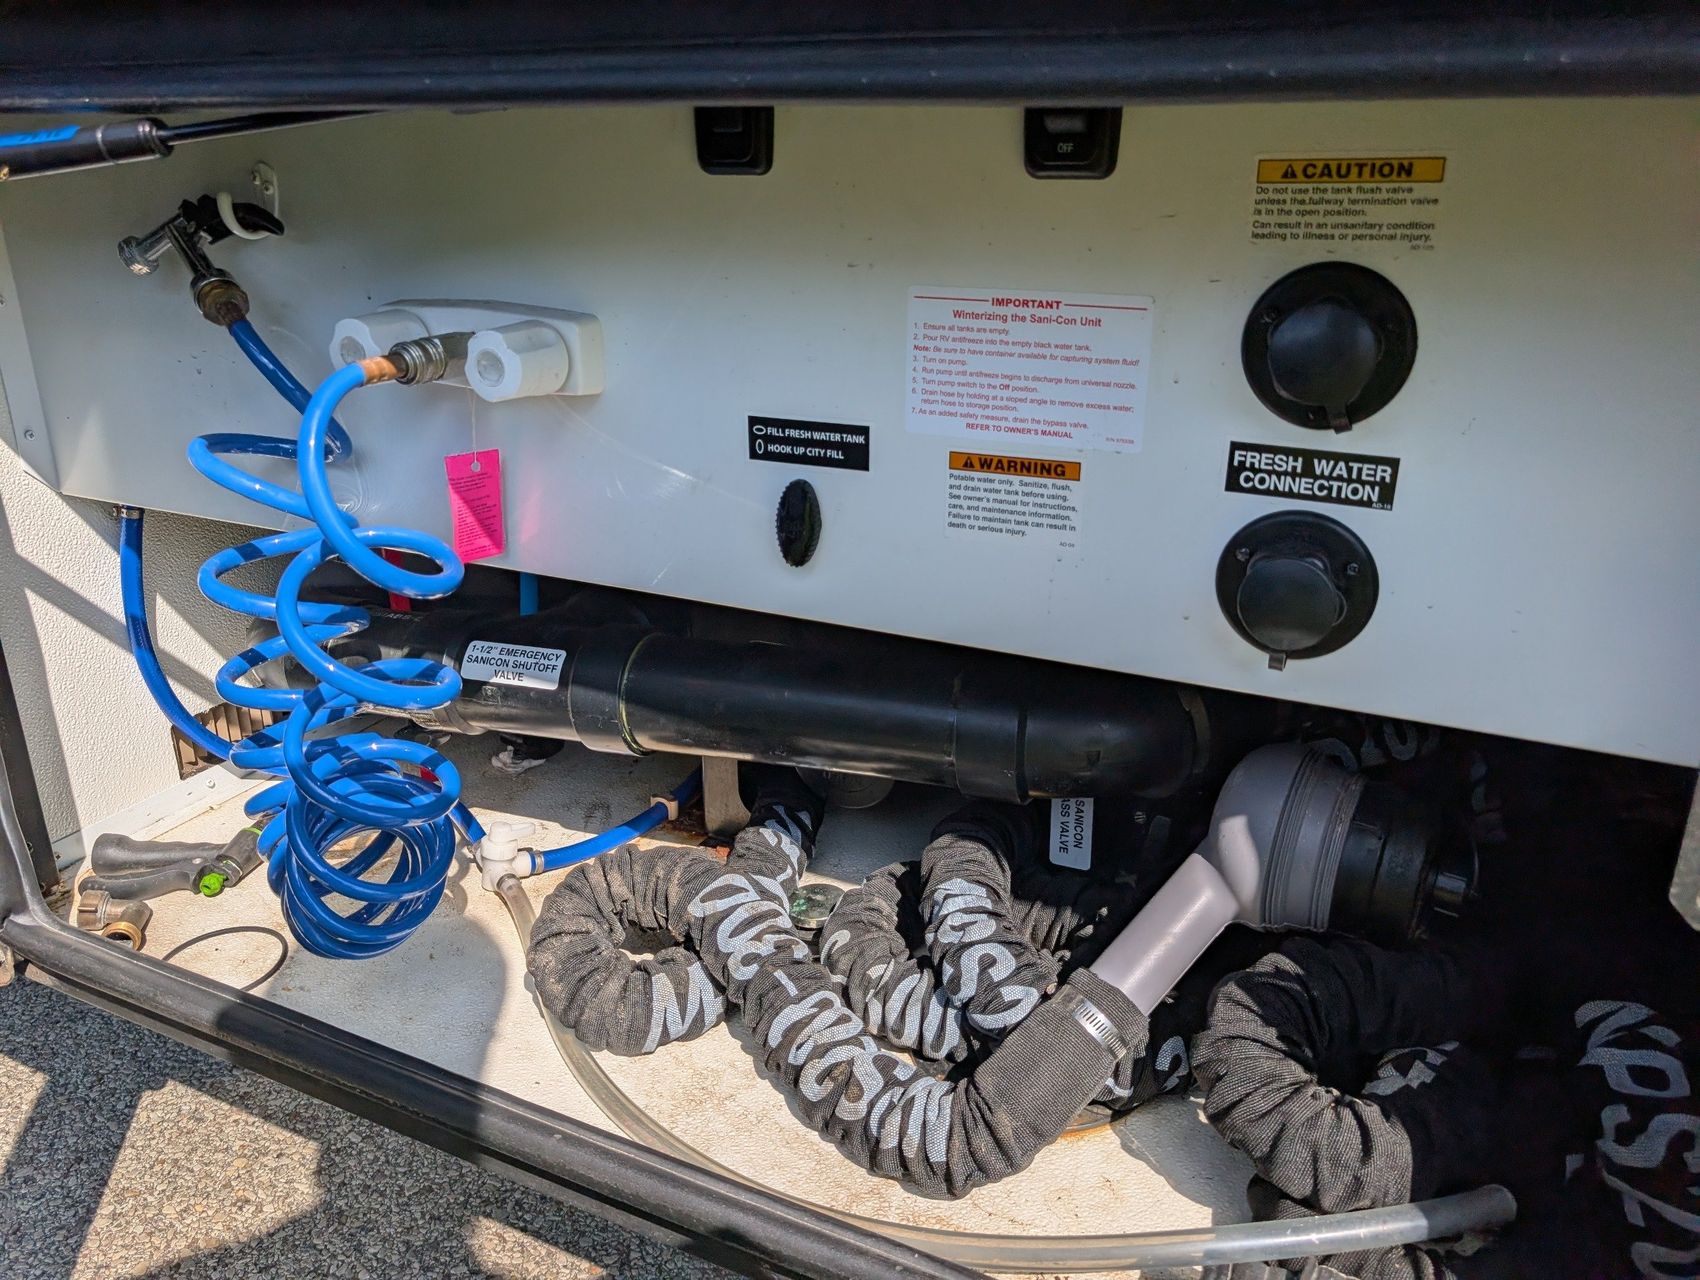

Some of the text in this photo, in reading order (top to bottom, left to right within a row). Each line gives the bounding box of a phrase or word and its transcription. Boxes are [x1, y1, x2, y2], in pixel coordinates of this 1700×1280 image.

[1057, 142, 1074, 153] OFF
[1302, 162, 1413, 178] CAUTION
[1257, 186, 1269, 194] Do
[1272, 186, 1288, 194] not
[1330, 186, 1352, 194] tank
[1356, 186, 1382, 194] flush
[1385, 186, 1413, 194] valve
[1308, 198, 1344, 207] fullway
[1254, 208, 1262, 216] is
[1265, 208, 1274, 216] in
[1295, 210, 1320, 218] open
[1253, 221, 1271, 229] Can
[1273, 221, 1301, 229] result
[1304, 221, 1313, 229] in
[1330, 221, 1383, 232] unsanitary
[1386, 222, 1434, 230] condition
[1252, 232, 1287, 242] leading
[1290, 232, 1299, 240] to
[1302, 232, 1334, 240] illness
[1351, 232, 1397, 242] personal
[992, 298, 1062, 309] IMPORTANT
[953, 310, 1102, 327] Winterizing the Sani-Con Unit
[767, 427, 865, 443] FILL FRESH WATER TANK
[966, 423, 1073, 438] REFER TO OWNER'S MANUAL
[768, 444, 844, 459] HOOK UP CITY FILL
[978, 457, 1066, 476] WARNING
[1233, 451, 1391, 483] FRESH WATER
[949, 474, 1072, 491] Potable water only. Sanitize, flush,
[1240, 472, 1379, 502] CONNECTION
[982, 486, 1001, 494] water
[1004, 488, 1019, 496] tank
[1021, 490, 1044, 498] before
[1046, 492, 1068, 502] using.
[962, 494, 990, 503] owner's
[992, 497, 1018, 505] manual
[1032, 501, 1077, 511] instructions,
[966, 504, 979, 512] and
[981, 506, 1026, 516] maintenance
[1028, 510, 1072, 521] information.
[948, 512, 971, 521] Failure
[981, 516, 1011, 525] maintain
[1046, 522, 1067, 530] result
[977, 524, 1003, 533] serious
[1005, 527, 1027, 537] injury.
[472, 645, 562, 661] 1-1/2" EMERGENCY
[467, 655, 558, 673] SANICON SHUTOFF
[494, 670, 524, 681] VALVE
[1074, 800, 1085, 849] SANICON
[1059, 821, 1069, 854] VALVE
